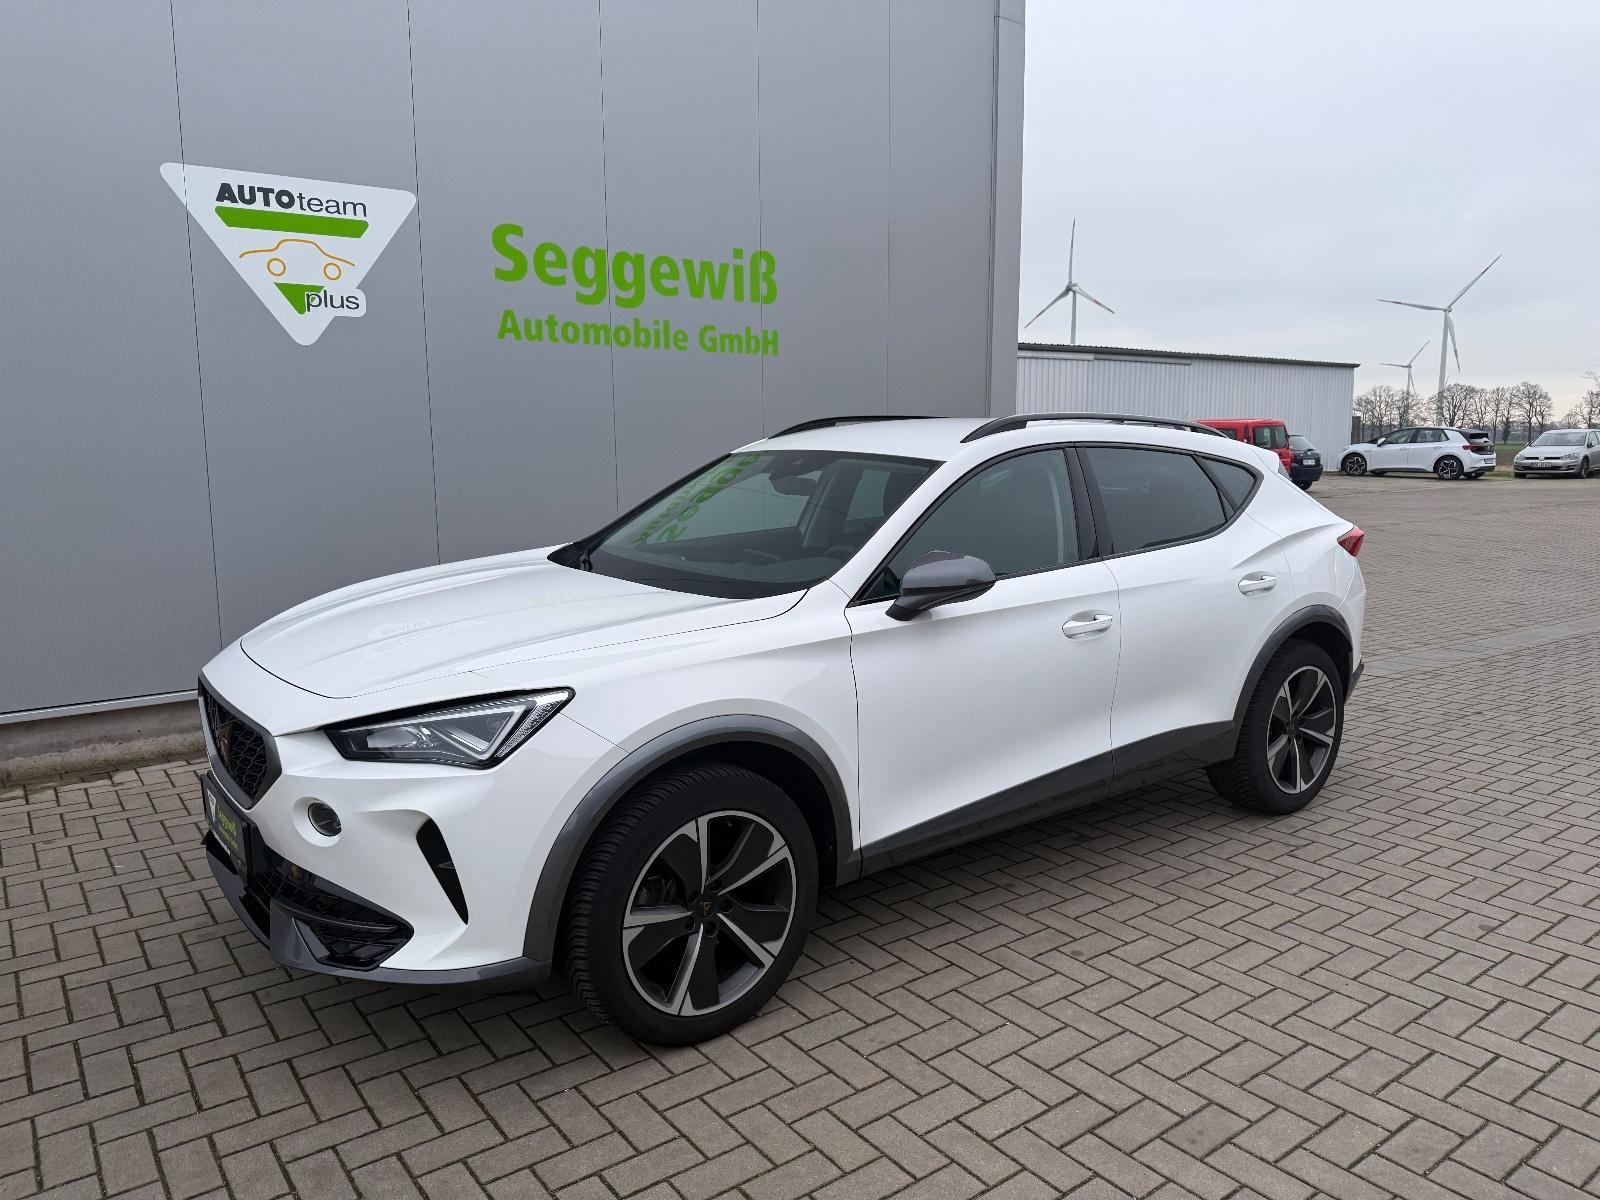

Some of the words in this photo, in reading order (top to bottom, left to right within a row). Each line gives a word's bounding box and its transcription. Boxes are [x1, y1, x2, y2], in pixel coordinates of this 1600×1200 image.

[215, 182, 368, 217] AUTOteam
[491, 223, 778, 309] Seggewiß
[305, 289, 360, 312] plus
[497, 309, 689, 351] Automobile
[698, 324, 779, 356] GmbH
